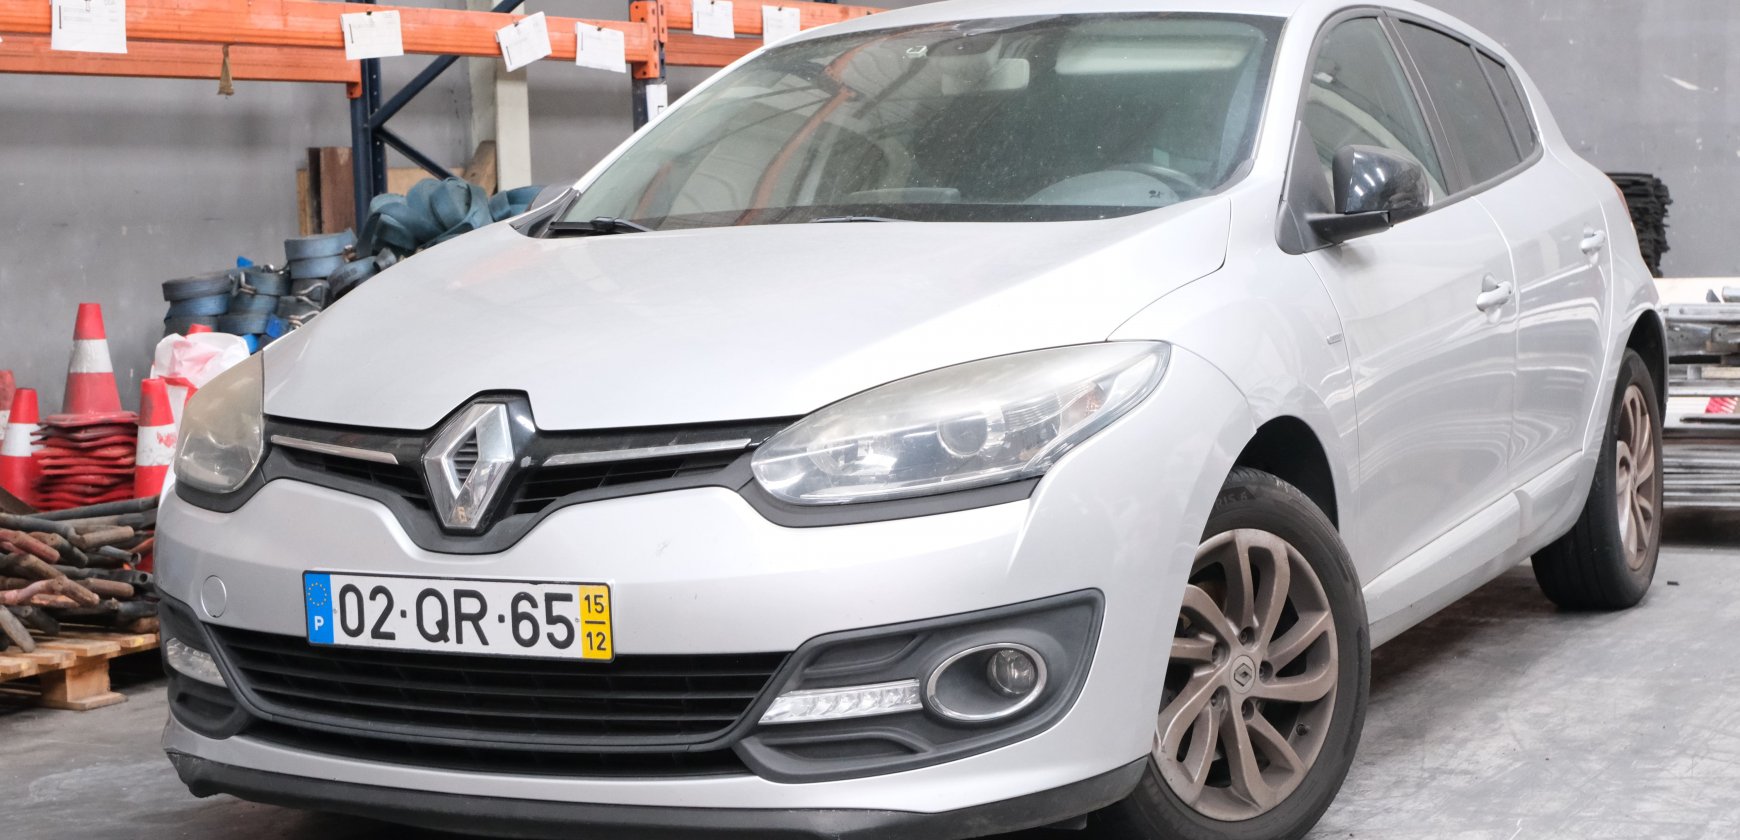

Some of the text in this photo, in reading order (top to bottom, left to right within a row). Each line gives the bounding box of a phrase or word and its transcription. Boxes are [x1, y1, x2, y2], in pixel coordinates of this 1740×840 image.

[584, 594, 605, 614] 15
[313, 615, 325, 631] P
[586, 631, 607, 651] 12
